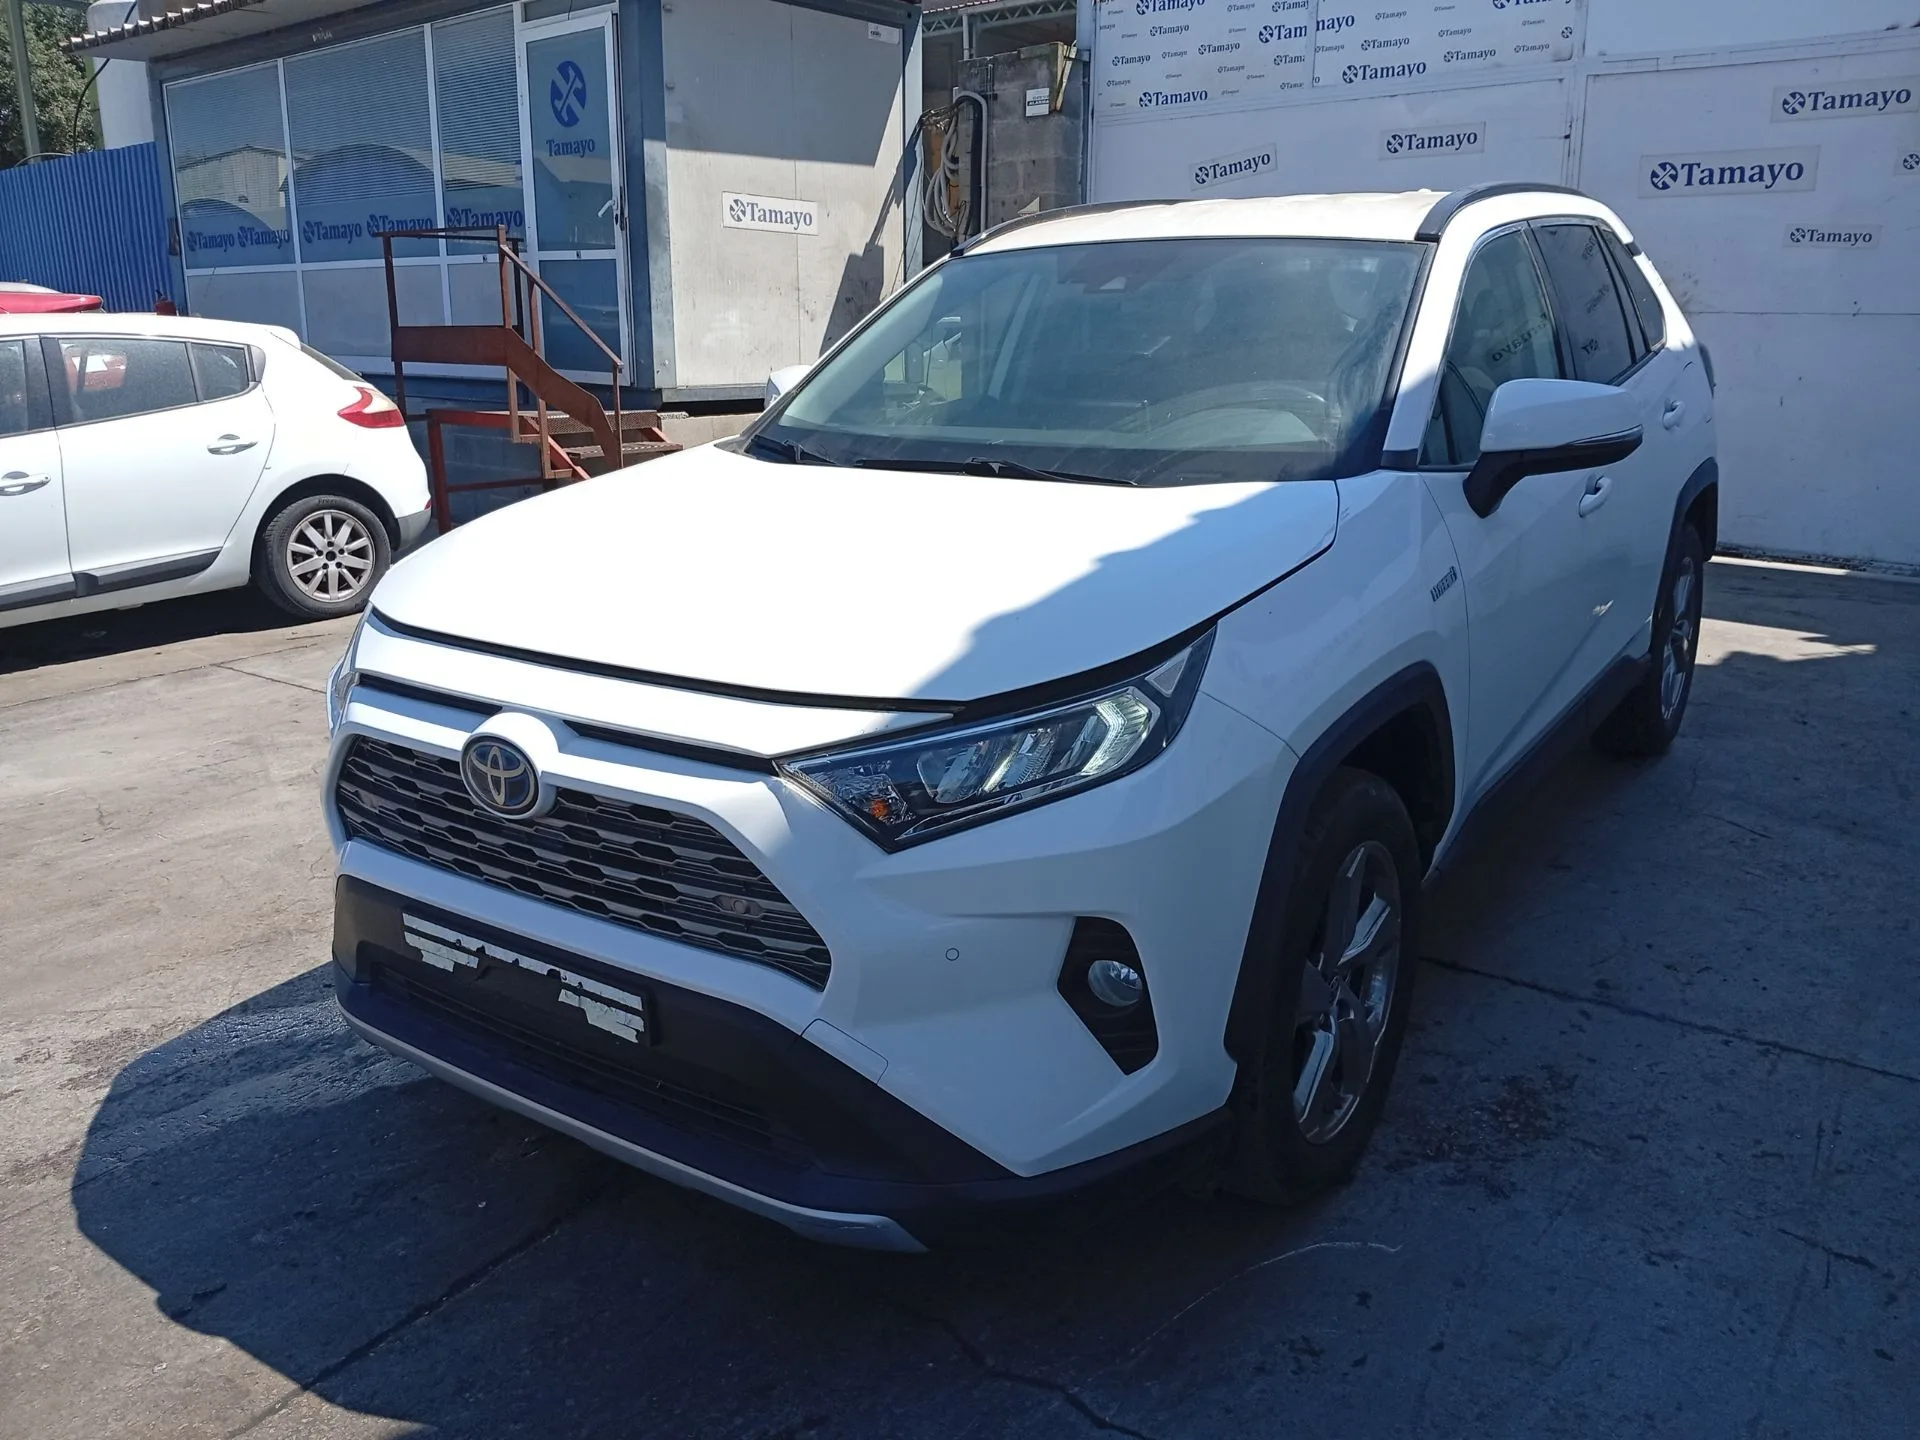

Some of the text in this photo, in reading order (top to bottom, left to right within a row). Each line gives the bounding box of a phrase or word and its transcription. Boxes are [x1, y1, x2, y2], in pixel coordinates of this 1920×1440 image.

[1316, 14, 1355, 34] mayo
[1382, 11, 1408, 20] Tamayo
[1157, 24, 1190, 36] Tamayo
[1274, 24, 1307, 41] Tam
[1445, 26, 1472, 37] Tamayo
[1206, 42, 1241, 54] Tamayo
[1371, 37, 1410, 50] Tamayo
[1521, 42, 1550, 54] Tamayo
[1120, 54, 1151, 66] Tamayo
[1454, 48, 1497, 62] Tamayo
[1359, 61, 1427, 81] Tamayo
[1808, 88, 1912, 111] Tamayo
[546, 138, 596, 159] Tamayo
[1403, 130, 1478, 153] Tamayo
[1208, 152, 1271, 180] Tamayo
[1681, 161, 1804, 189] Tamayo
[461, 208, 523, 232] Tamayo
[747, 201, 813, 231] Tamayo
[196, 230, 236, 253] Tamayo
[247, 226, 291, 250] Tamayo
[314, 221, 362, 244] Tamayo
[1807, 229, 1872, 246] Tamayo
